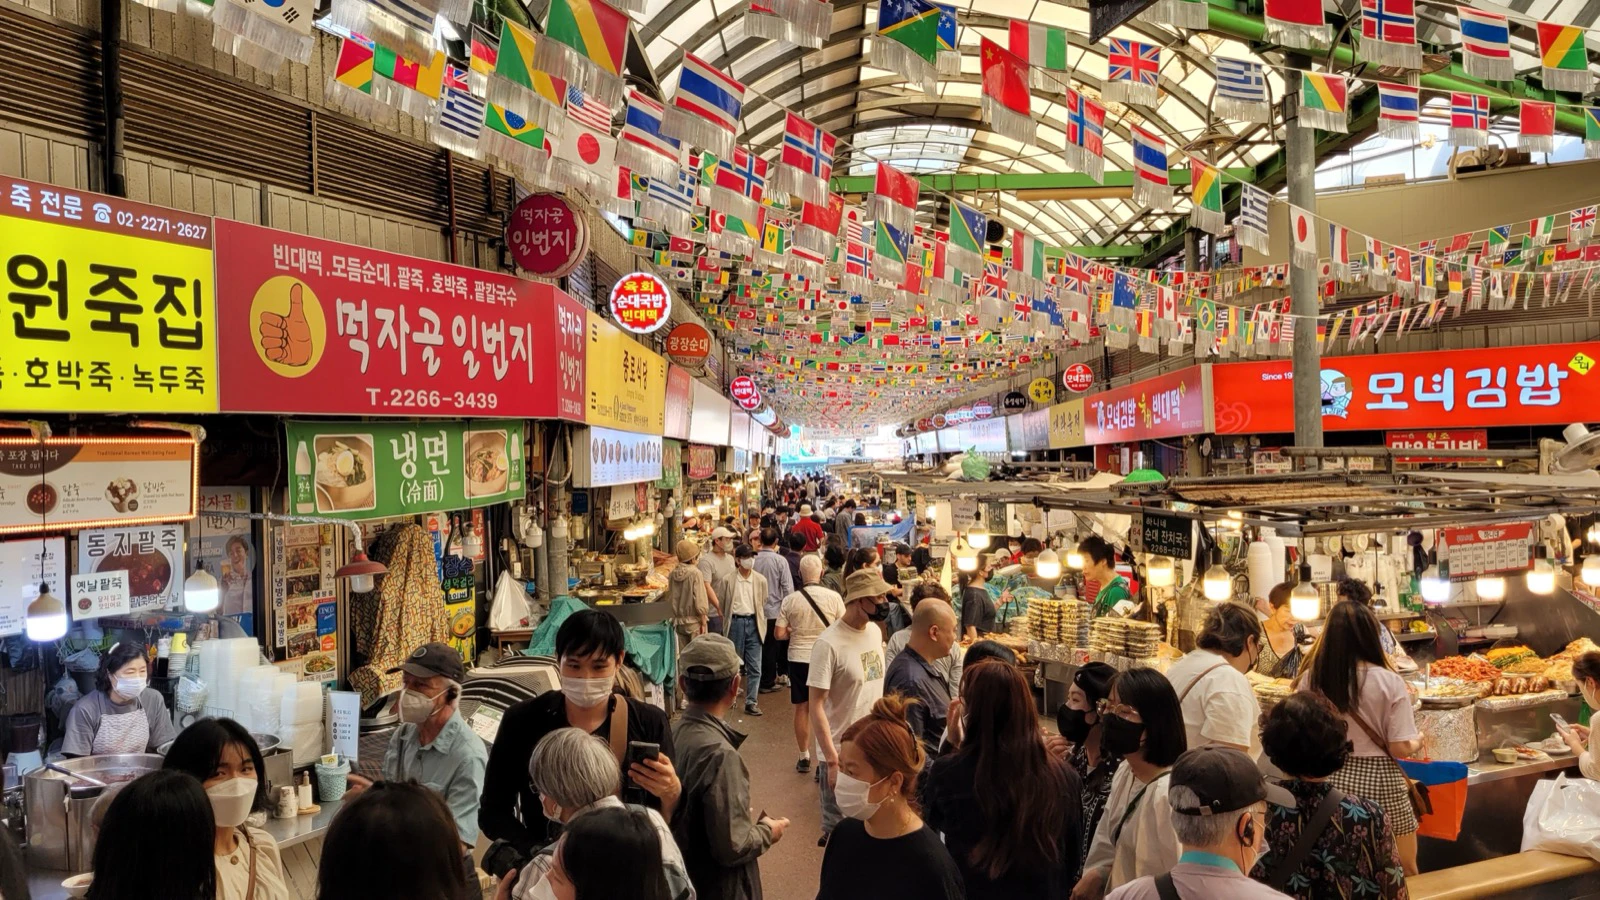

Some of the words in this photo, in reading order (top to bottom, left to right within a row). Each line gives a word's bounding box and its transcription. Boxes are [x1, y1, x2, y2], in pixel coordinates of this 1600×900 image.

[10, 184, 31, 212] 죽
[40, 190, 83, 220] 전문
[116, 211, 207, 240] 02-2271-2627
[520, 207, 564, 225] 먹자골
[512, 229, 570, 256] 일번지
[6, 254, 204, 351] 원죽집
[616, 294, 664, 310] 순대국밥
[558, 304, 583, 353] 먹자골
[622, 309, 658, 323] 빈대떡
[670, 336, 708, 353] 광장순대
[560, 351, 583, 396] 일번지
[623, 349, 648, 390] 종로식당
[1262, 373, 1282, 381] Since
[1283, 371, 1294, 380] 19
[366, 387, 498, 409] T.2266-3439
[1365, 362, 1569, 412] 모녀김밥
[1152, 387, 1181, 425] 빈대떡
[8, 450, 26, 461] 포장
[389, 430, 450, 478] 냉면
[62, 483, 80, 497] 팥죽
[143, 482, 166, 494] 팥빙수
[400, 477, 444, 506] (冷面)
[87, 529, 177, 557] 동지팥죽
[1145, 528, 1159, 541] 순대
[76, 579, 98, 594] 옛날
[100, 577, 123, 591] 팥죽
[275, 577, 284, 607] 냉방중
